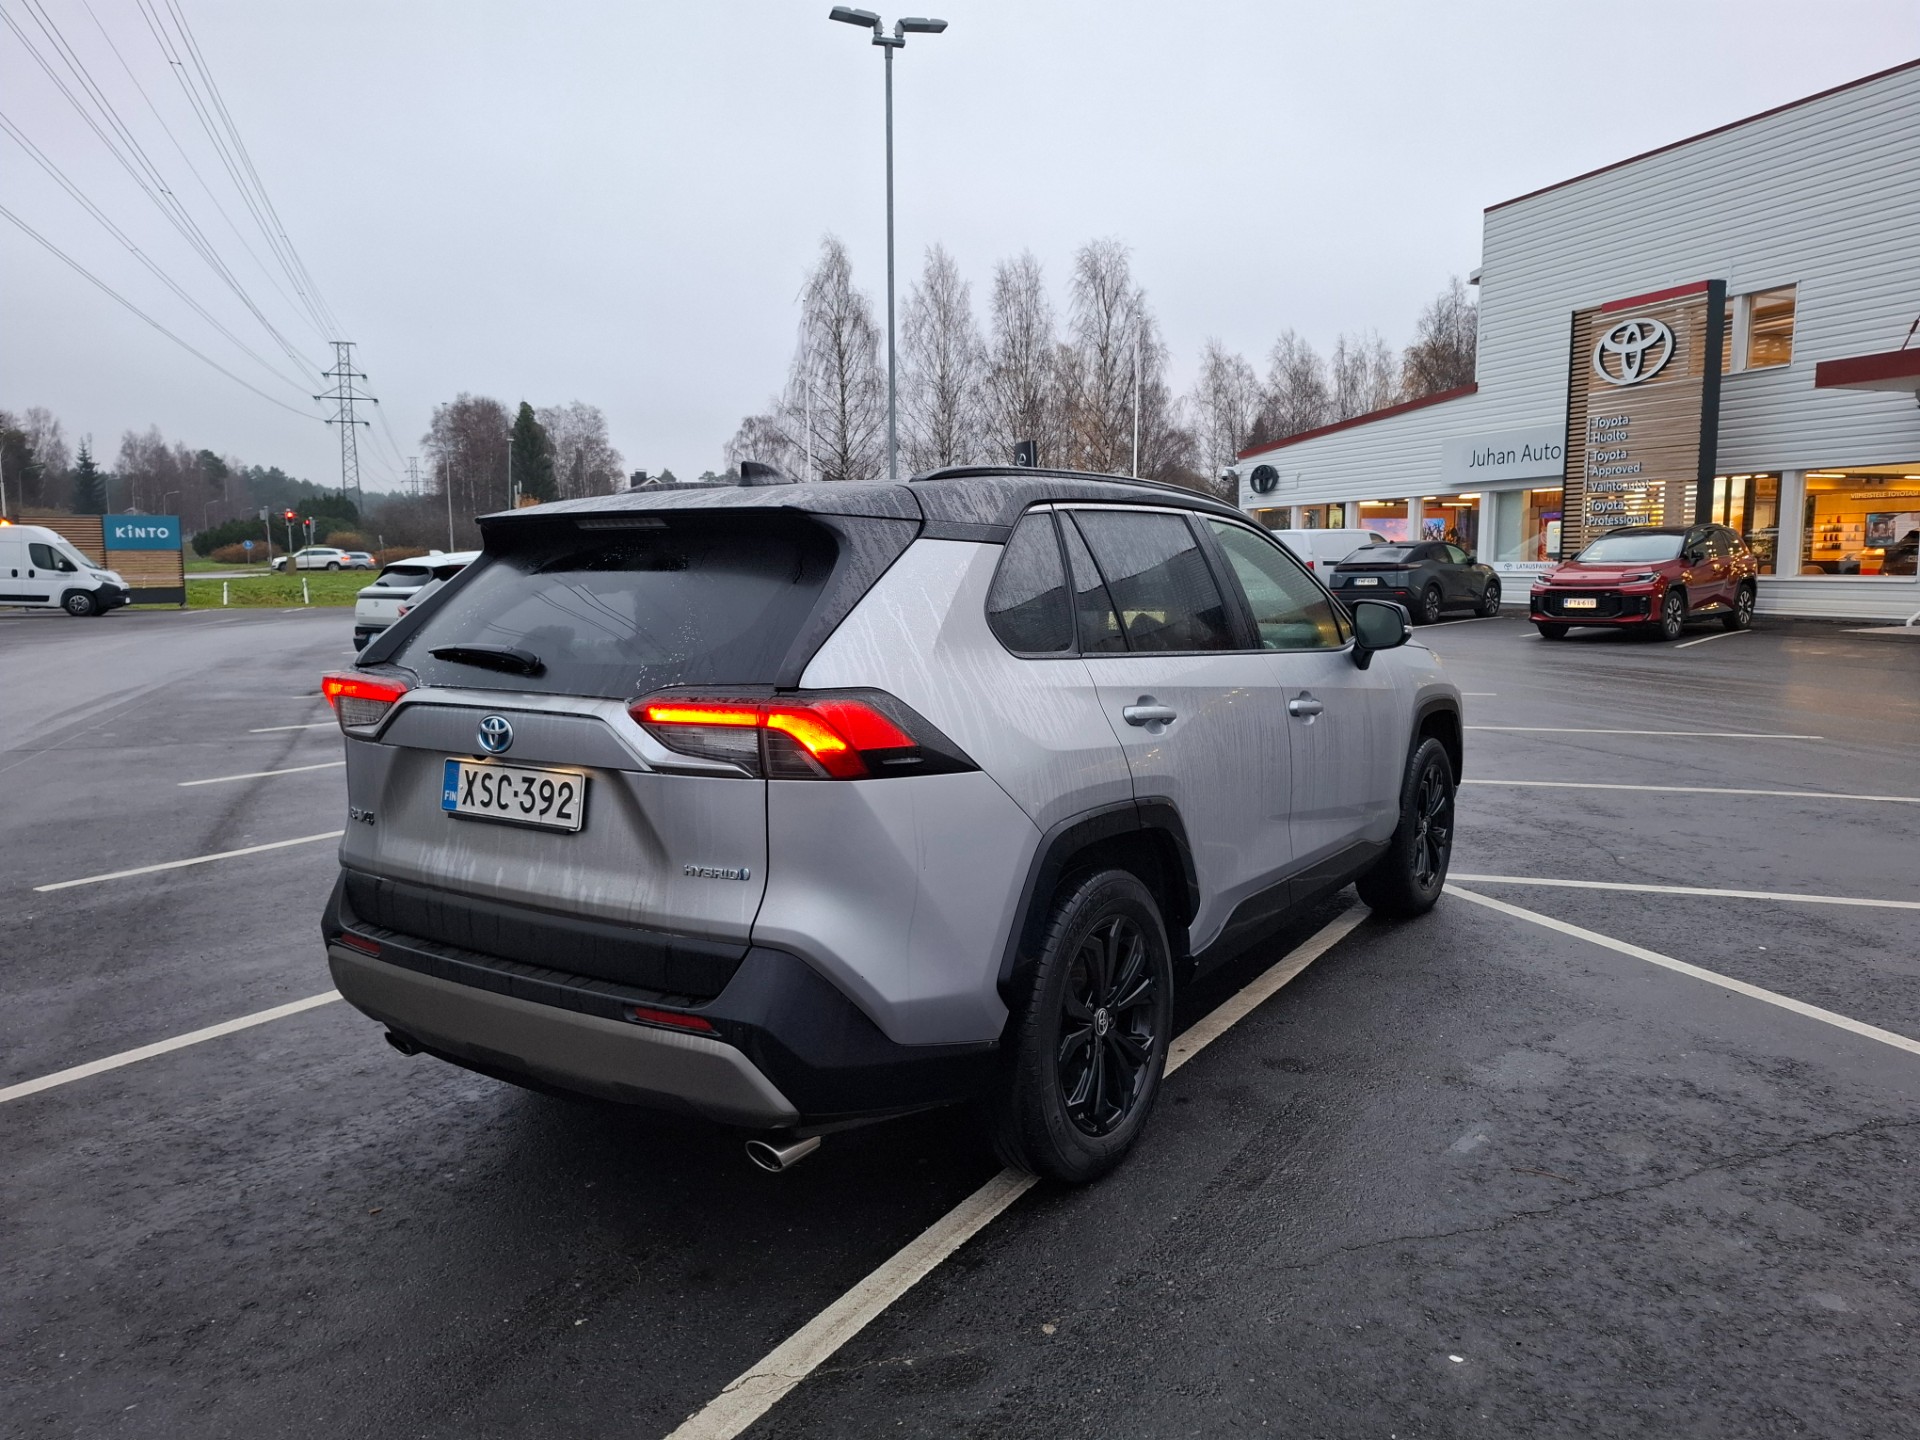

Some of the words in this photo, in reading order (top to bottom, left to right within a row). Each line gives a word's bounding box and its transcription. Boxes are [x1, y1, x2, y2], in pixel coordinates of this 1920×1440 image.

[1595, 415, 1629, 429] Toyota
[1592, 430, 1627, 442] Huolto
[1469, 447, 1516, 468] Juhan
[1520, 443, 1562, 463] Auto
[1593, 449, 1627, 463] Toyota
[1591, 462, 1641, 477] Approved
[1590, 500, 1625, 513] Toyota
[1588, 514, 1649, 526] Professional
[683, 864, 740, 880] HYBRID
